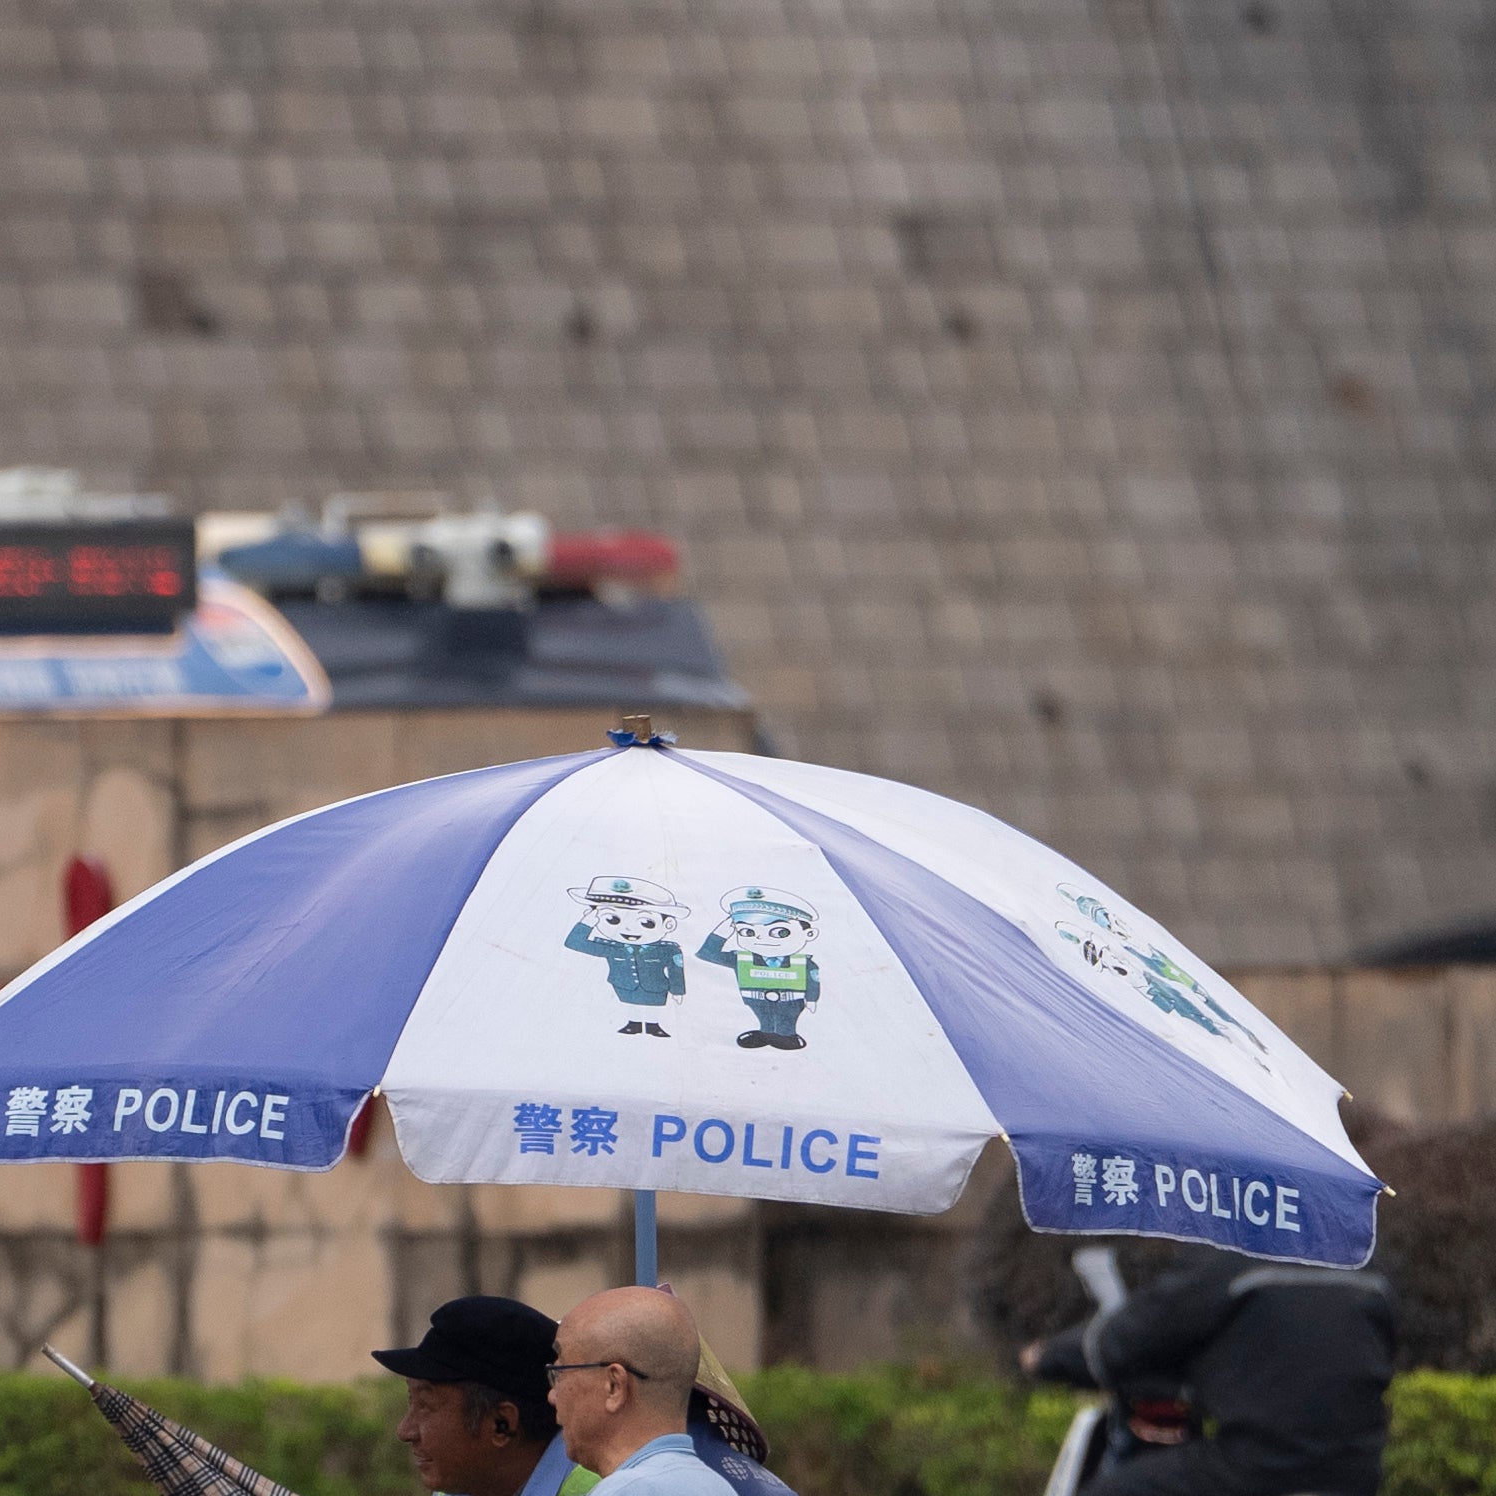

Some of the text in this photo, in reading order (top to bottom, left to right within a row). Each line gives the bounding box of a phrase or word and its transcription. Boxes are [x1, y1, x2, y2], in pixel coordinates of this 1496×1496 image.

[5, 1085, 291, 1141] 警察 POLICE
[512, 1102, 883, 1181] 警察 POLICE
[1071, 1153, 1302, 1234] 警察 POLICE
